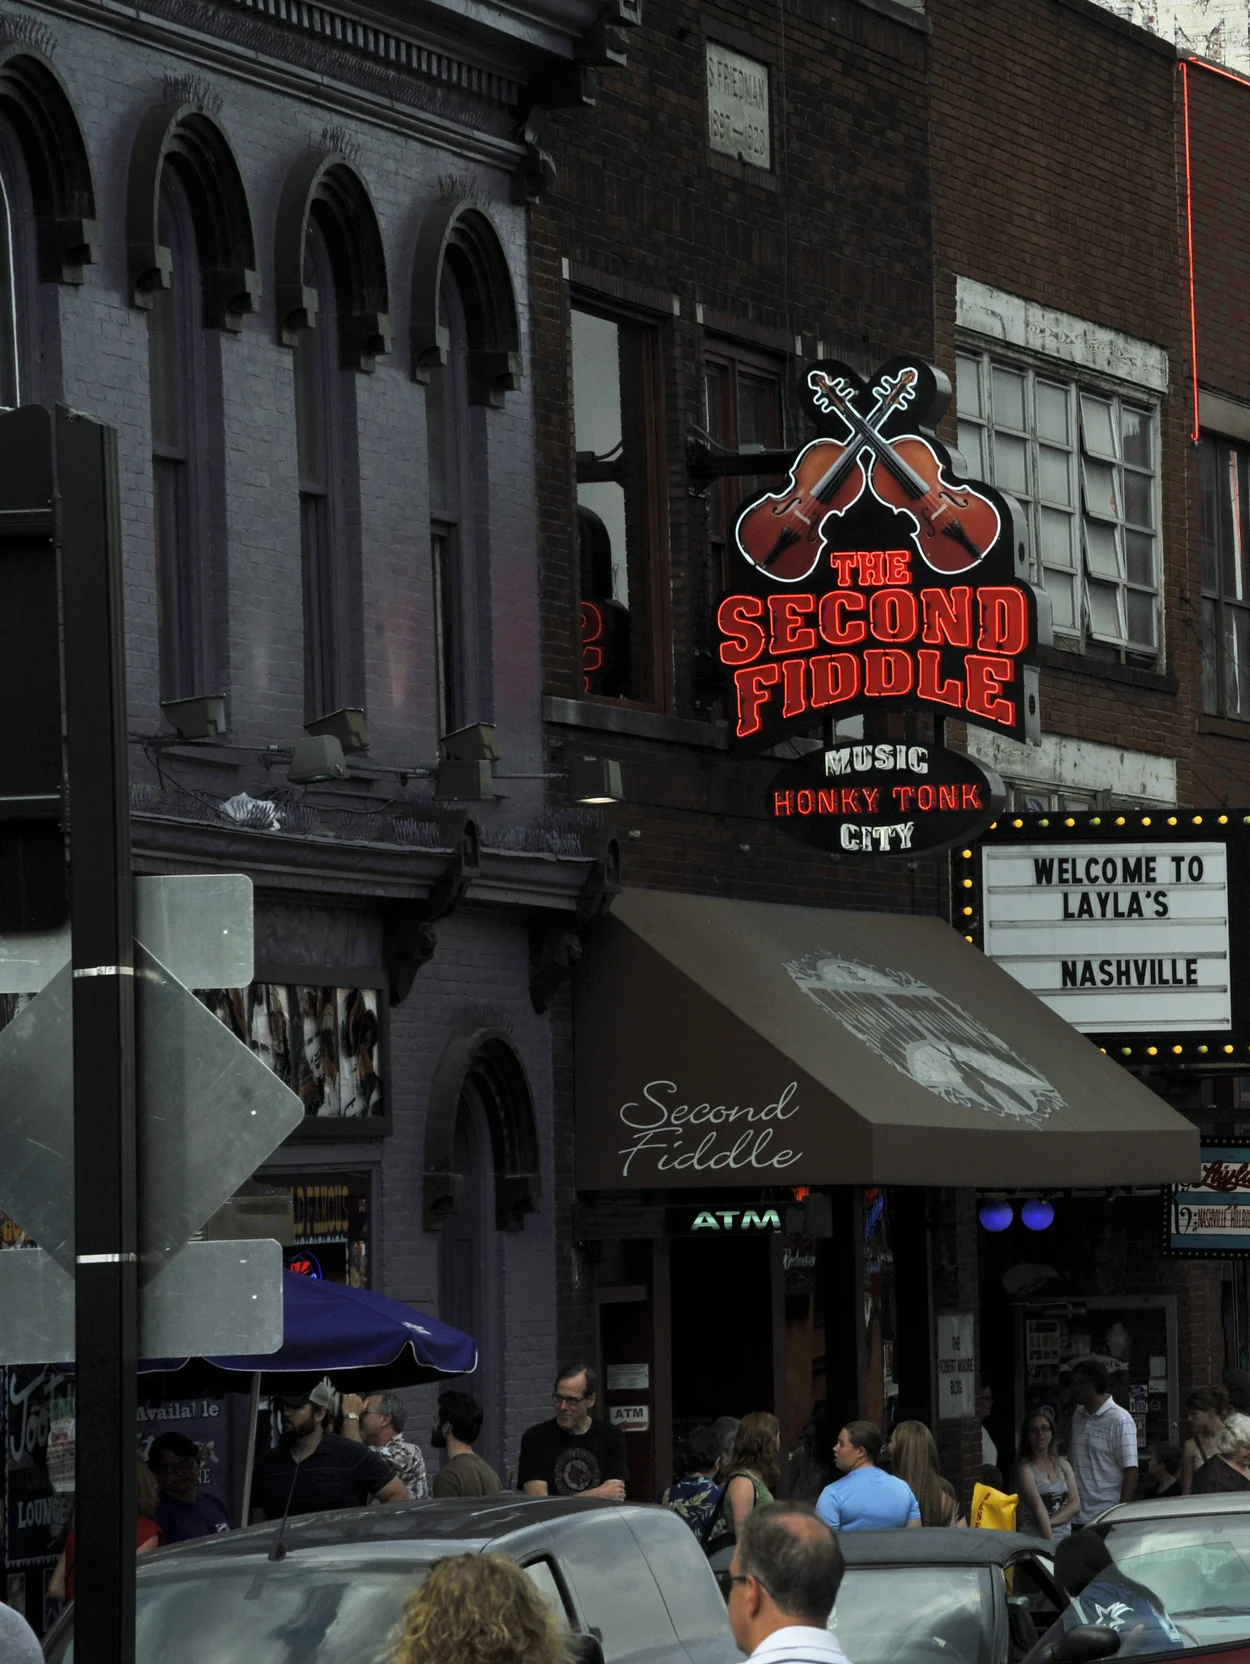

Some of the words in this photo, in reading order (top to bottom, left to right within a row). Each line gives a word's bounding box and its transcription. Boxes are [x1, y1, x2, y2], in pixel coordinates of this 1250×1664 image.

[831, 550, 912, 587] THE
[718, 586, 1030, 666] SECOND
[734, 649, 1017, 738] FIDDLE
[825, 744, 929, 777] MUSIC
[774, 787, 879, 817] HONKY
[892, 783, 984, 812] TONK
[840, 822, 915, 852] CITY
[1034, 857, 1157, 885] WELCOME
[1171, 855, 1204, 883] TO
[1063, 890, 1169, 919] LAYLA'S
[1061, 958, 1199, 987] NASHVILLE
[618, 1080, 800, 1130] Second
[617, 1126, 803, 1177] Fiddle
[690, 1209, 783, 1231] ATM
[1197, 1208, 1228, 1229] NASHVILLE
[137, 1400, 220, 1422] Availale
[614, 1408, 644, 1419] ATM
